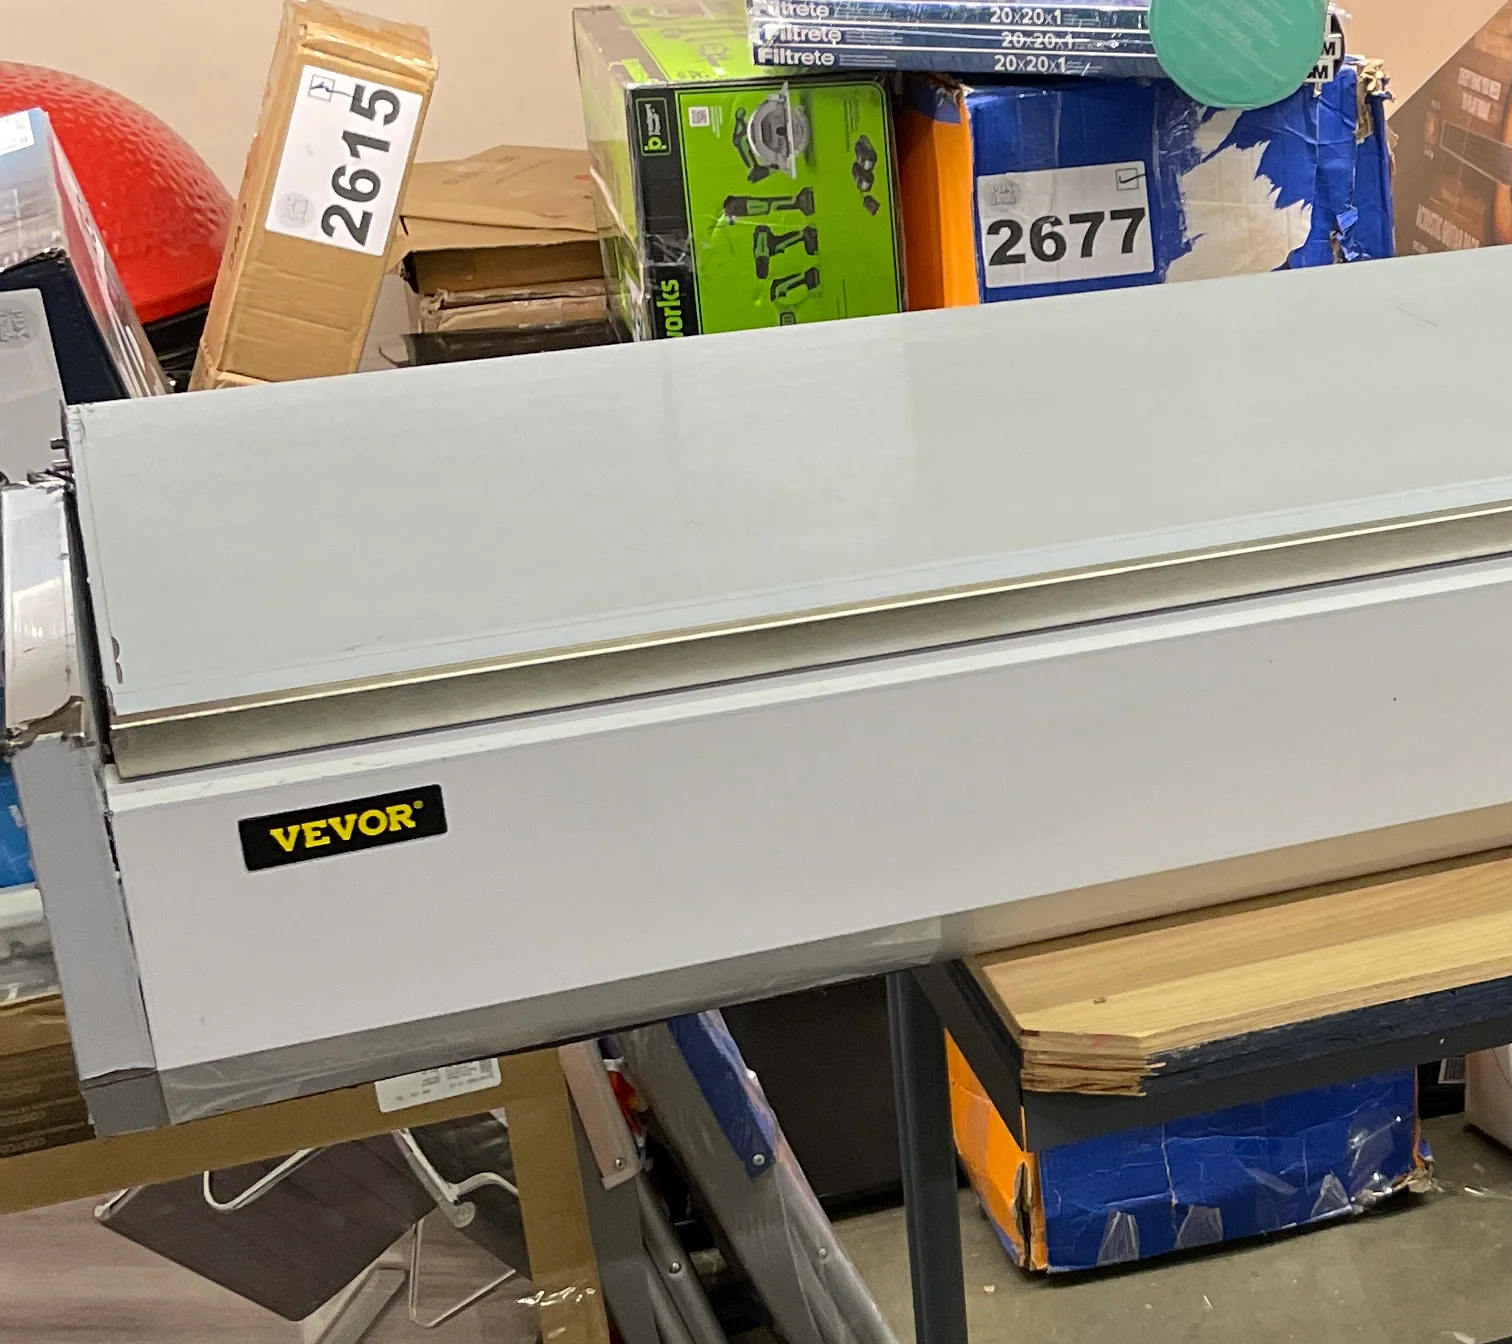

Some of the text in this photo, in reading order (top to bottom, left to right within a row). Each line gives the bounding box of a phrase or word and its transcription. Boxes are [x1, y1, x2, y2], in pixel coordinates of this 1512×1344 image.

[757, 46, 836, 67] Filtrete
[320, 82, 401, 248] 2615
[986, 207, 1146, 267] 2677
